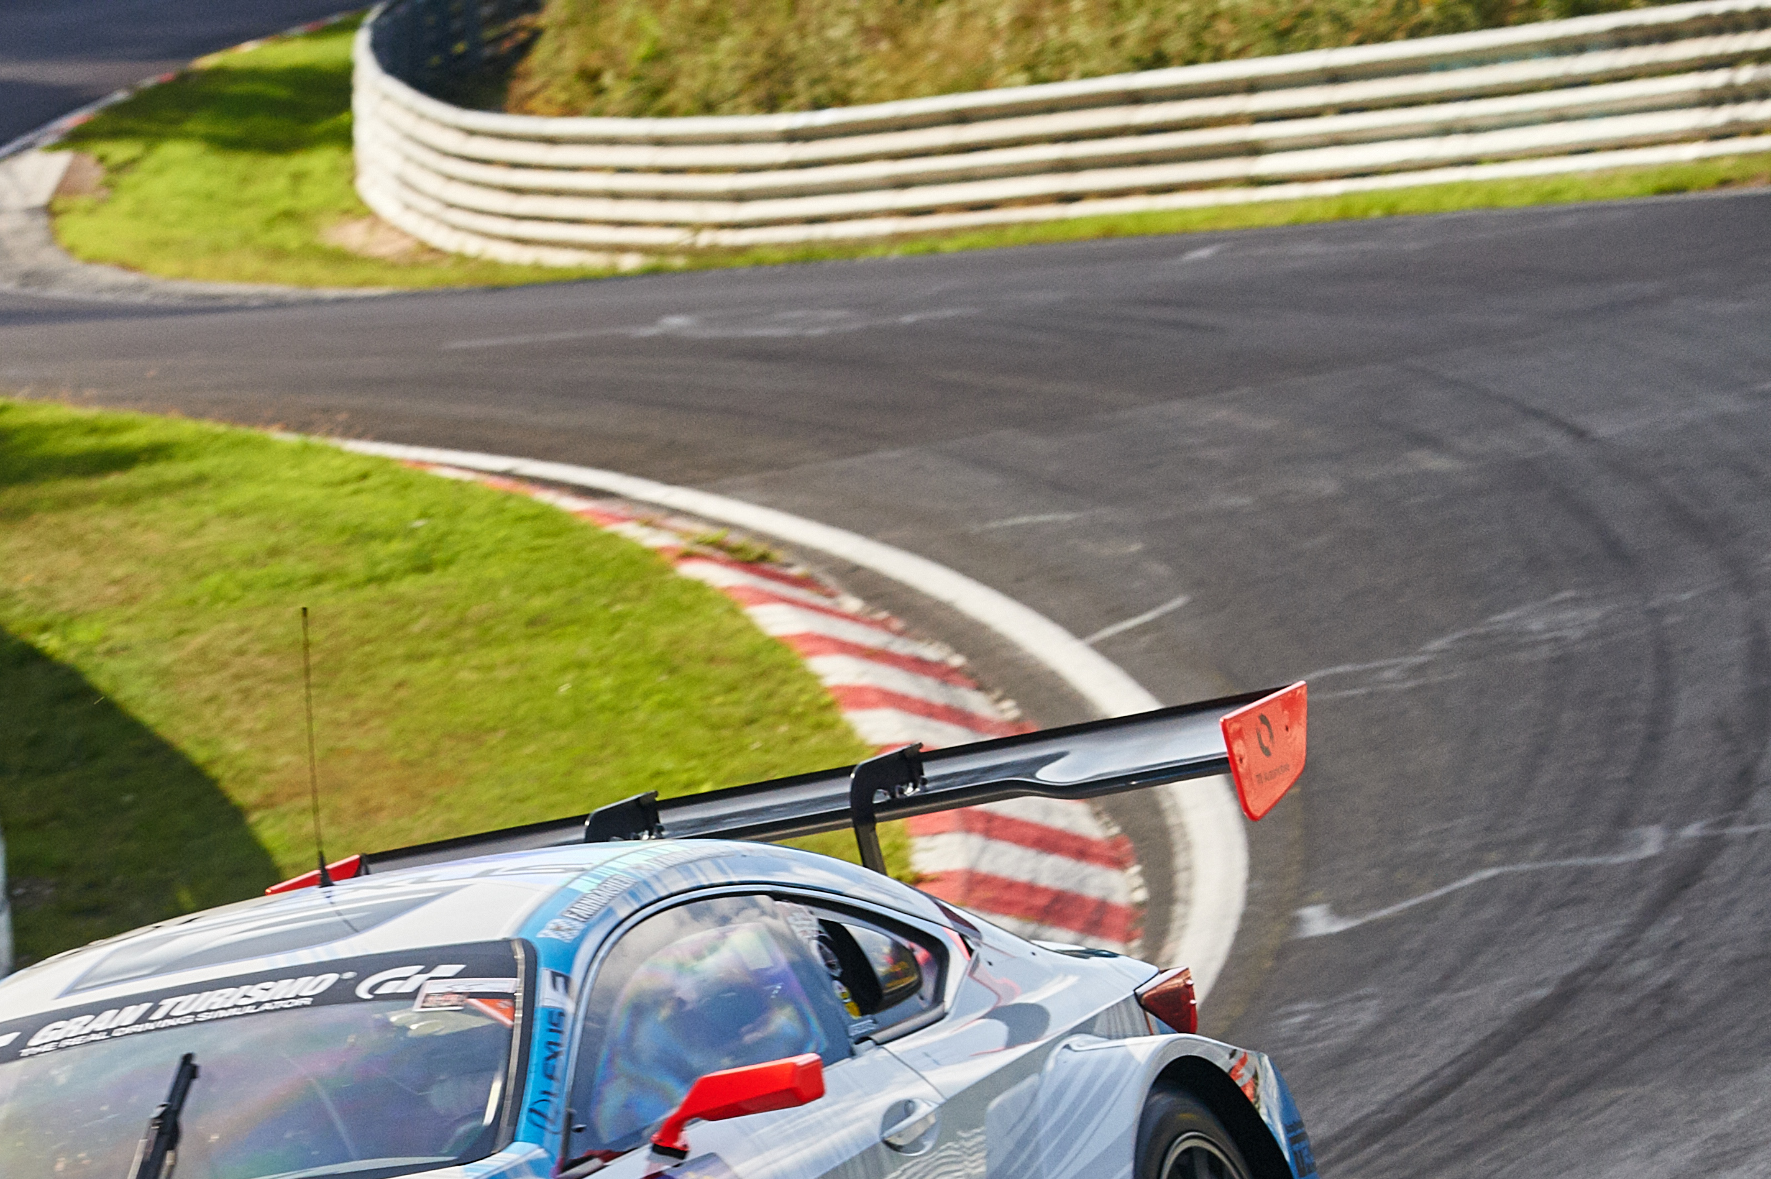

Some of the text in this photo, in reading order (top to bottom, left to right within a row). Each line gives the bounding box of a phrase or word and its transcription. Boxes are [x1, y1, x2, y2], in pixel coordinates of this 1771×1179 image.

[19, 997, 314, 1058] THE REAL DRIVING SIMULATOR
[26, 972, 342, 1047] GRAN TURISMO
